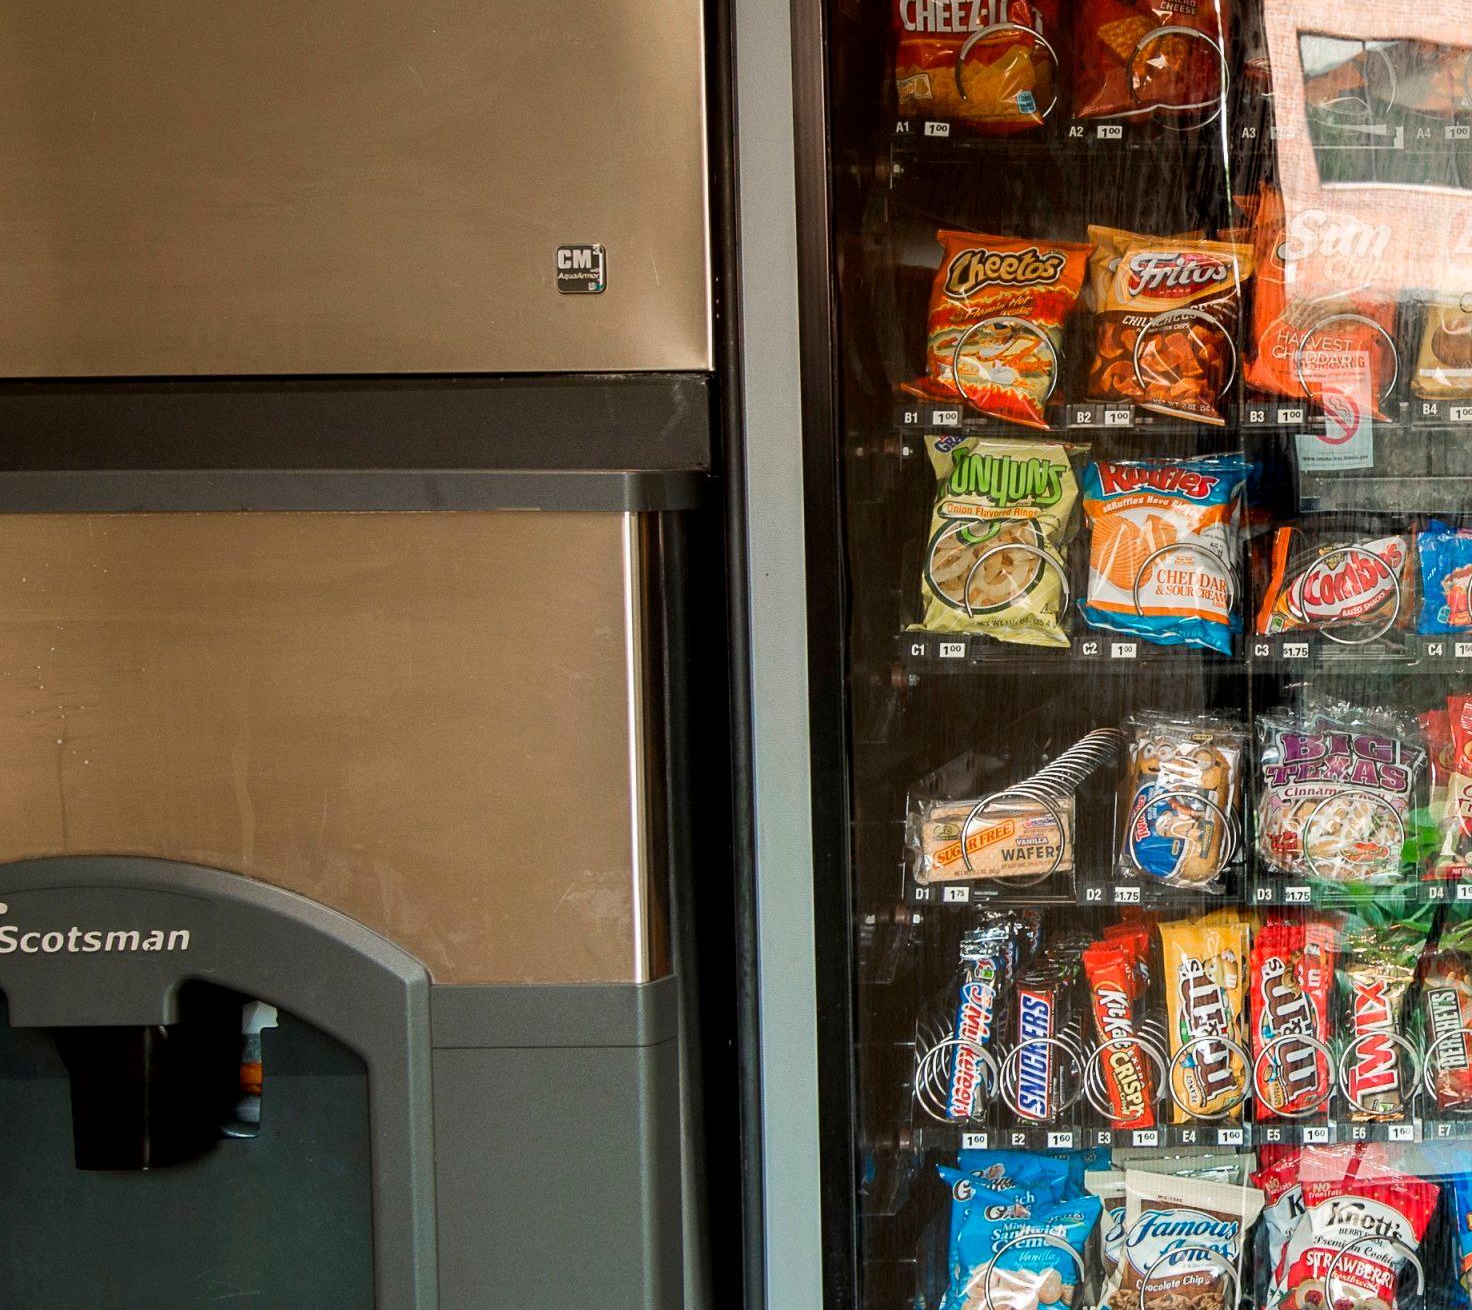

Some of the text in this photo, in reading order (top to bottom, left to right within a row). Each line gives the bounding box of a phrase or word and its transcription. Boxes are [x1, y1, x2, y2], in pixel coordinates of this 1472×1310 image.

[1160, 1, 1198, 16] CHEESE
[896, 122, 910, 133] A1
[1069, 125, 1083, 137] A2
[1242, 127, 1256, 138] A3
[1417, 127, 1431, 139] A4
[945, 247, 1068, 297] Cheetos
[1129, 252, 1227, 296] Fritos
[1423, 403, 1437, 415] B4
[904, 412, 918, 424] B1
[1077, 411, 1091, 423] B2
[1250, 411, 1265, 423] B3
[1098, 461, 1219, 499] Ruffles
[947, 503, 972, 515] Onion
[975, 506, 1011, 517] Flavored
[912, 645, 925, 656] C1
[1083, 643, 1098, 655] C2
[1255, 645, 1269, 656] C3
[1284, 647, 1308, 657] $1.75
[1428, 644, 1443, 655] C4
[1280, 734, 1394, 764] BIG
[1266, 757, 1407, 791] TEXAS
[1016, 837, 1048, 845] VANILLA
[916, 889, 929, 900] D1
[1087, 889, 1101, 900] D2
[1116, 892, 1139, 900] $1.75
[1258, 889, 1272, 900] D3
[1430, 888, 1444, 898] D4
[1430, 991, 1466, 1070] HERSHEY'S
[1350, 980, 1398, 1106] TWIX
[1020, 995, 1048, 1117] SNICKERS
[1110, 1051, 1145, 1117] CRISPY
[1183, 1131, 1196, 1142] E4
[1268, 1130, 1280, 1141] E5
[1353, 1127, 1366, 1139] E6
[1438, 1125, 1451, 1136] E7
[1012, 1134, 1025, 1145] E2
[1098, 1132, 1111, 1143] E3
[1327, 1201, 1403, 1239] Knott's
[992, 1225, 1068, 1241] Sandwich
[1127, 1209, 1239, 1247] Famous
[1339, 1228, 1363, 1237] BERRY
[1019, 1251, 1055, 1262] Vanilla
